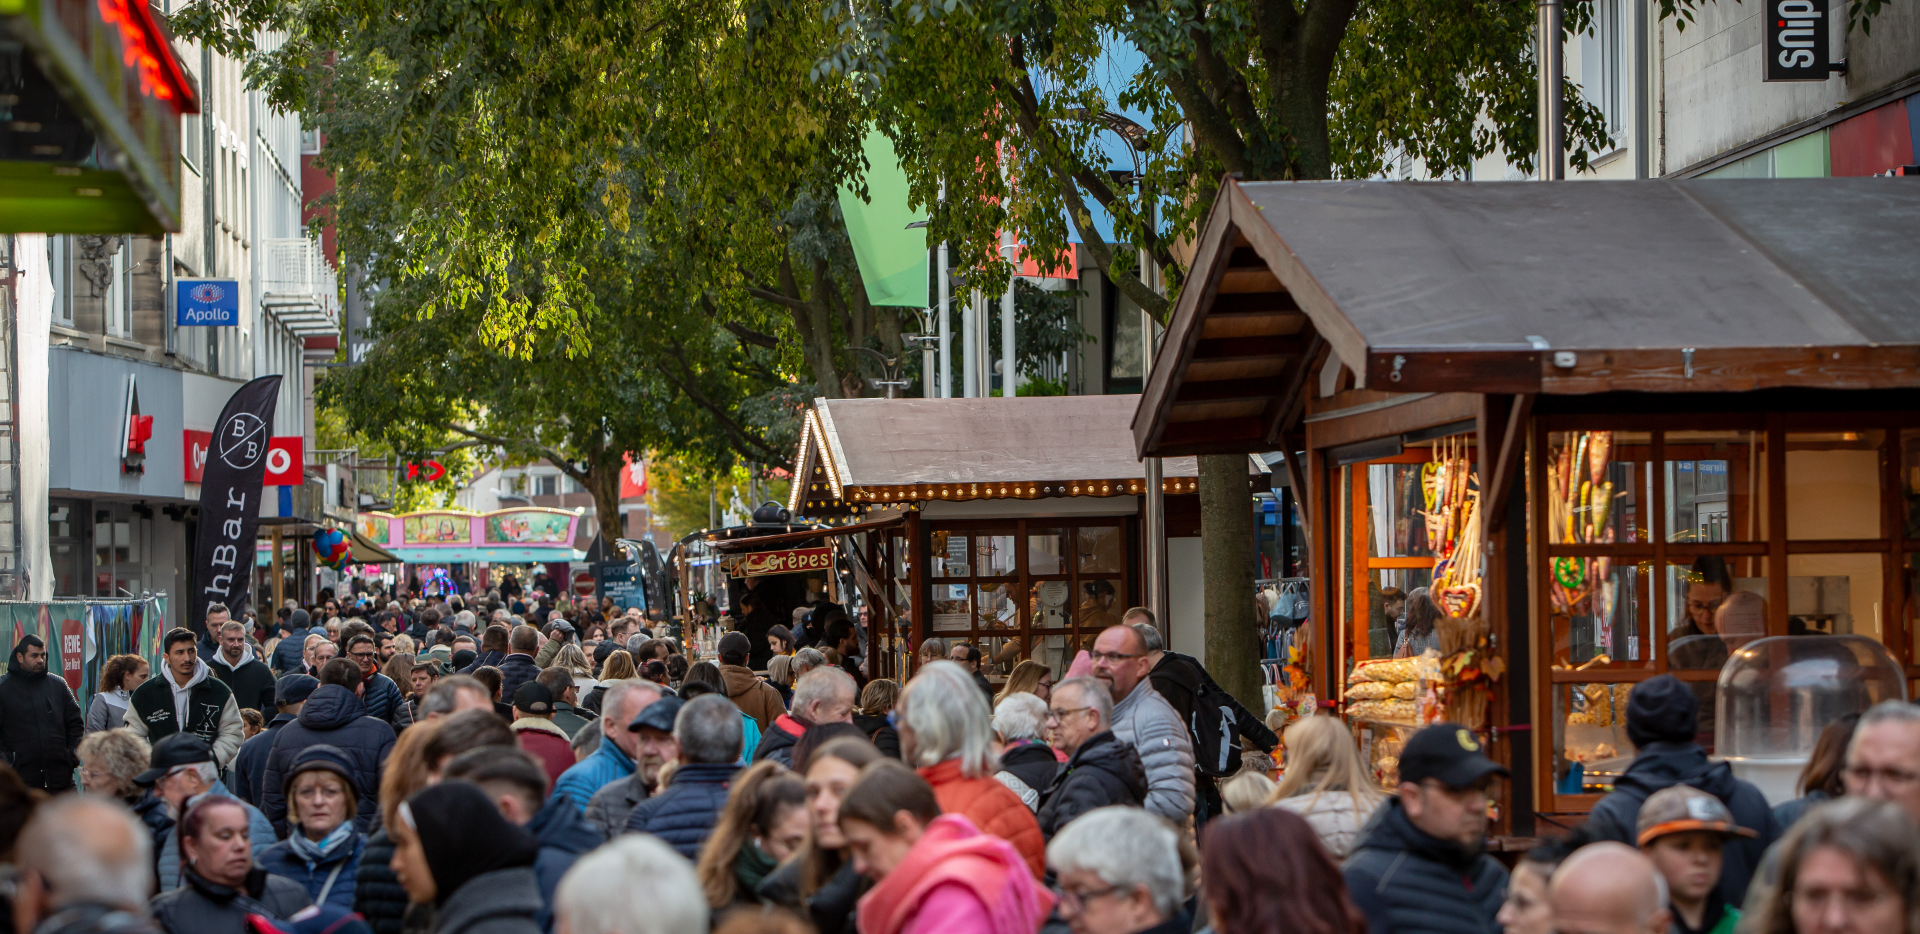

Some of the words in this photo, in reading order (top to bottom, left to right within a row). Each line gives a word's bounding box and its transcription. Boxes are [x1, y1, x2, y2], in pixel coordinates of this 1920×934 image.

[185, 308, 230, 323] Apollo
[231, 419, 246, 437] B
[244, 441, 258, 459] B
[766, 551, 830, 571] Crêpes
[64, 634, 81, 654] REWE
